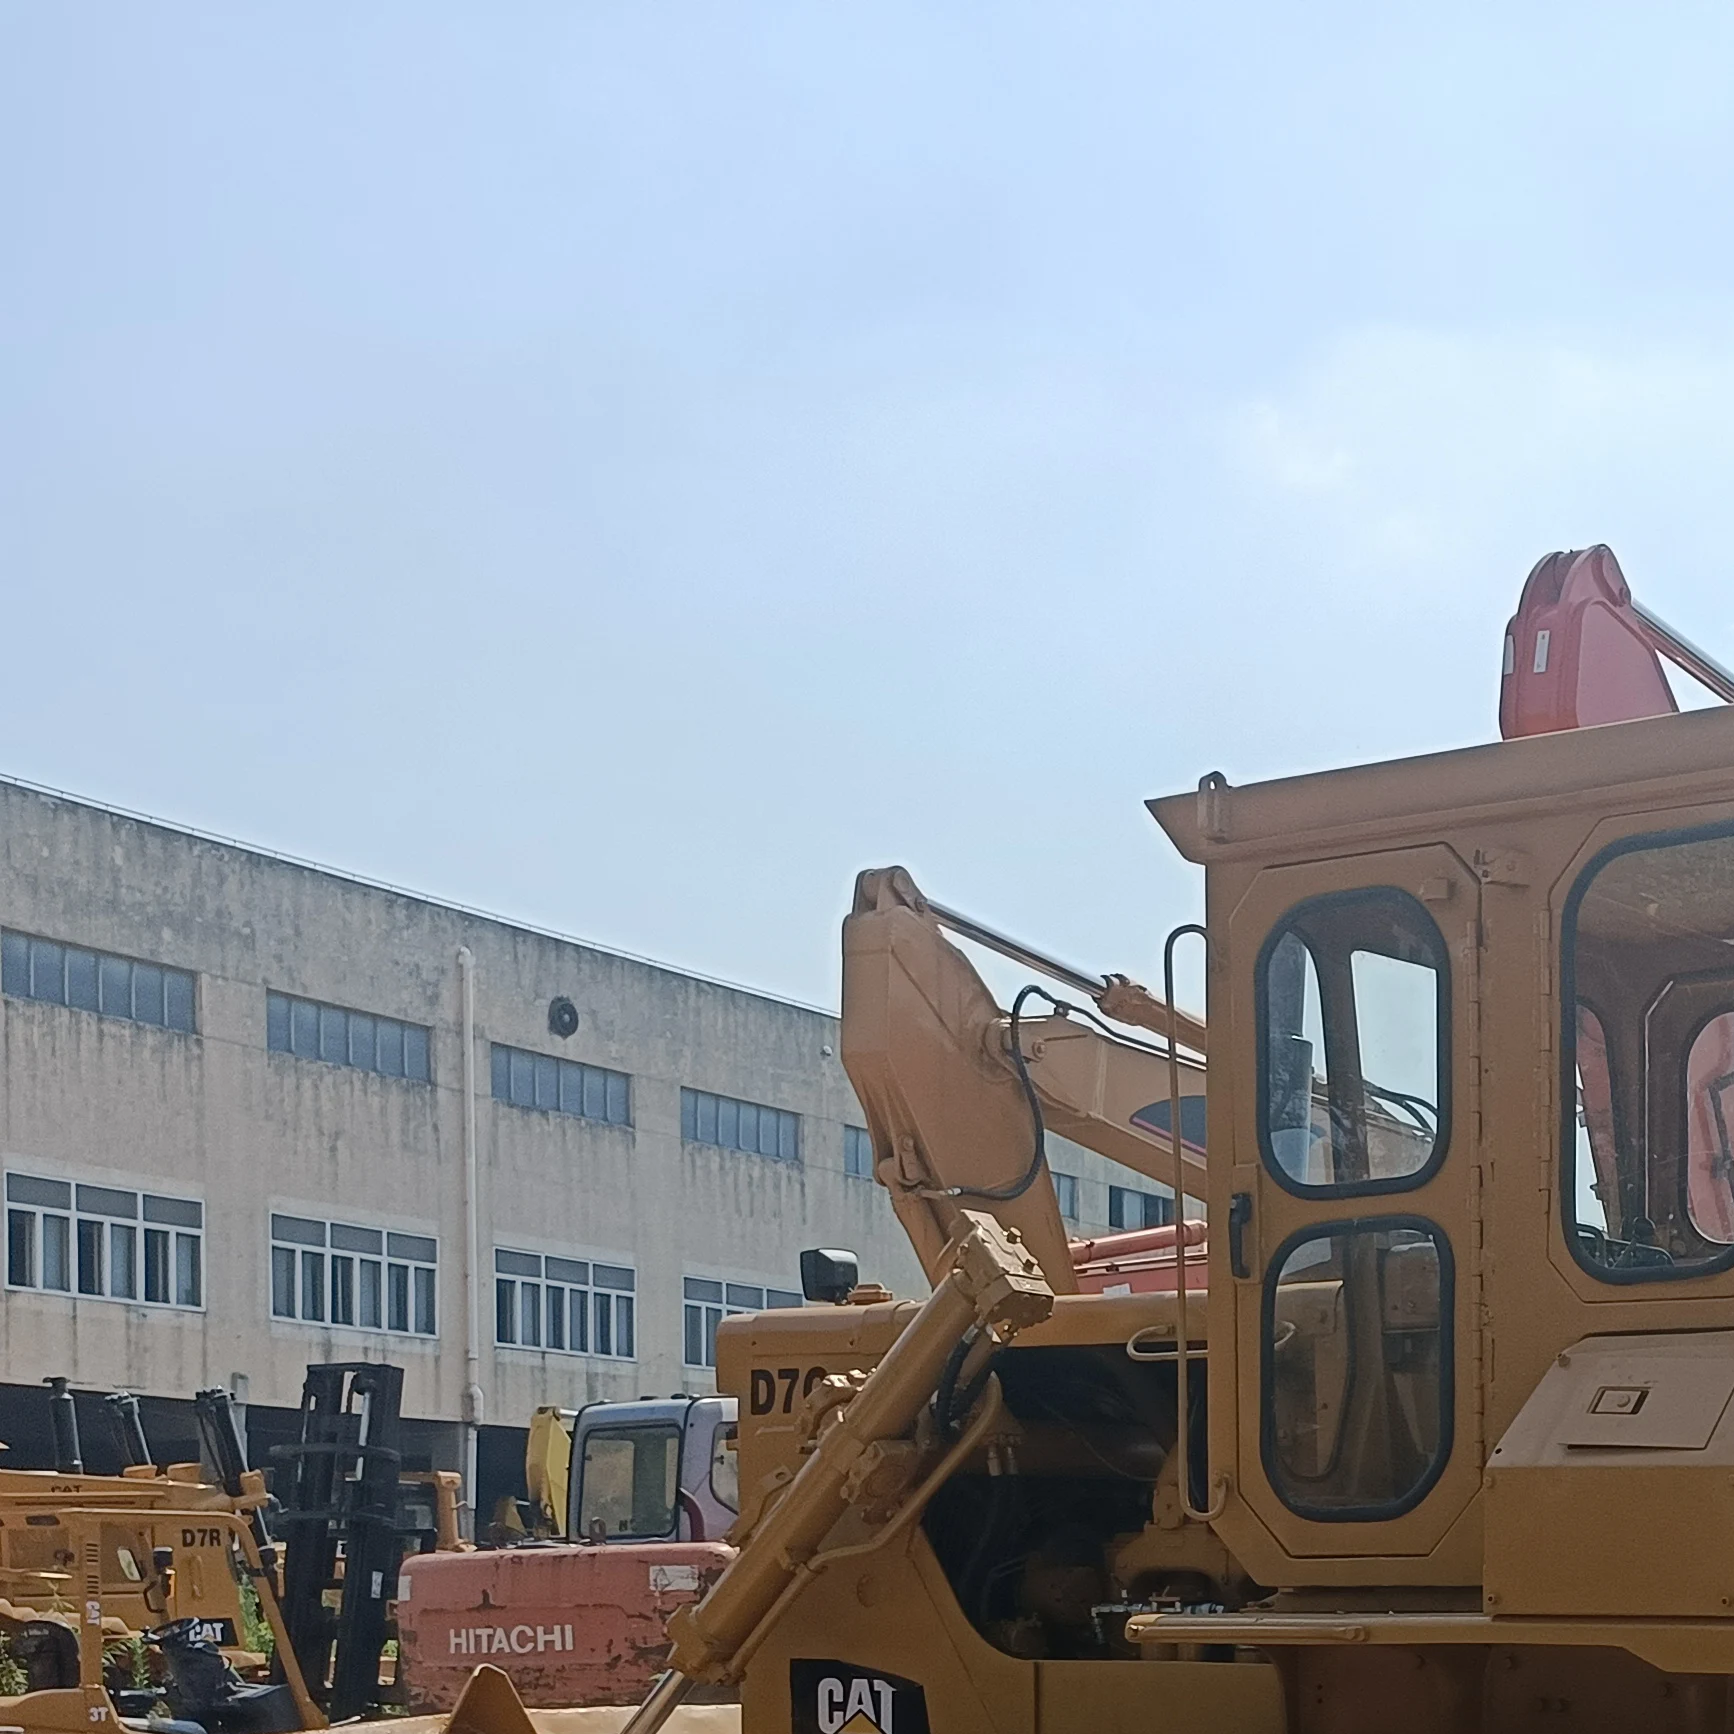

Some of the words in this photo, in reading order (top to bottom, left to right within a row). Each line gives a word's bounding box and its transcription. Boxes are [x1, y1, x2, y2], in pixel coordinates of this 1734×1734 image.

[181, 1528, 222, 1548] D7R
[189, 1622, 224, 1642] CAT
[449, 1624, 574, 1654] HITACHI
[89, 1706, 109, 1722] 3T
